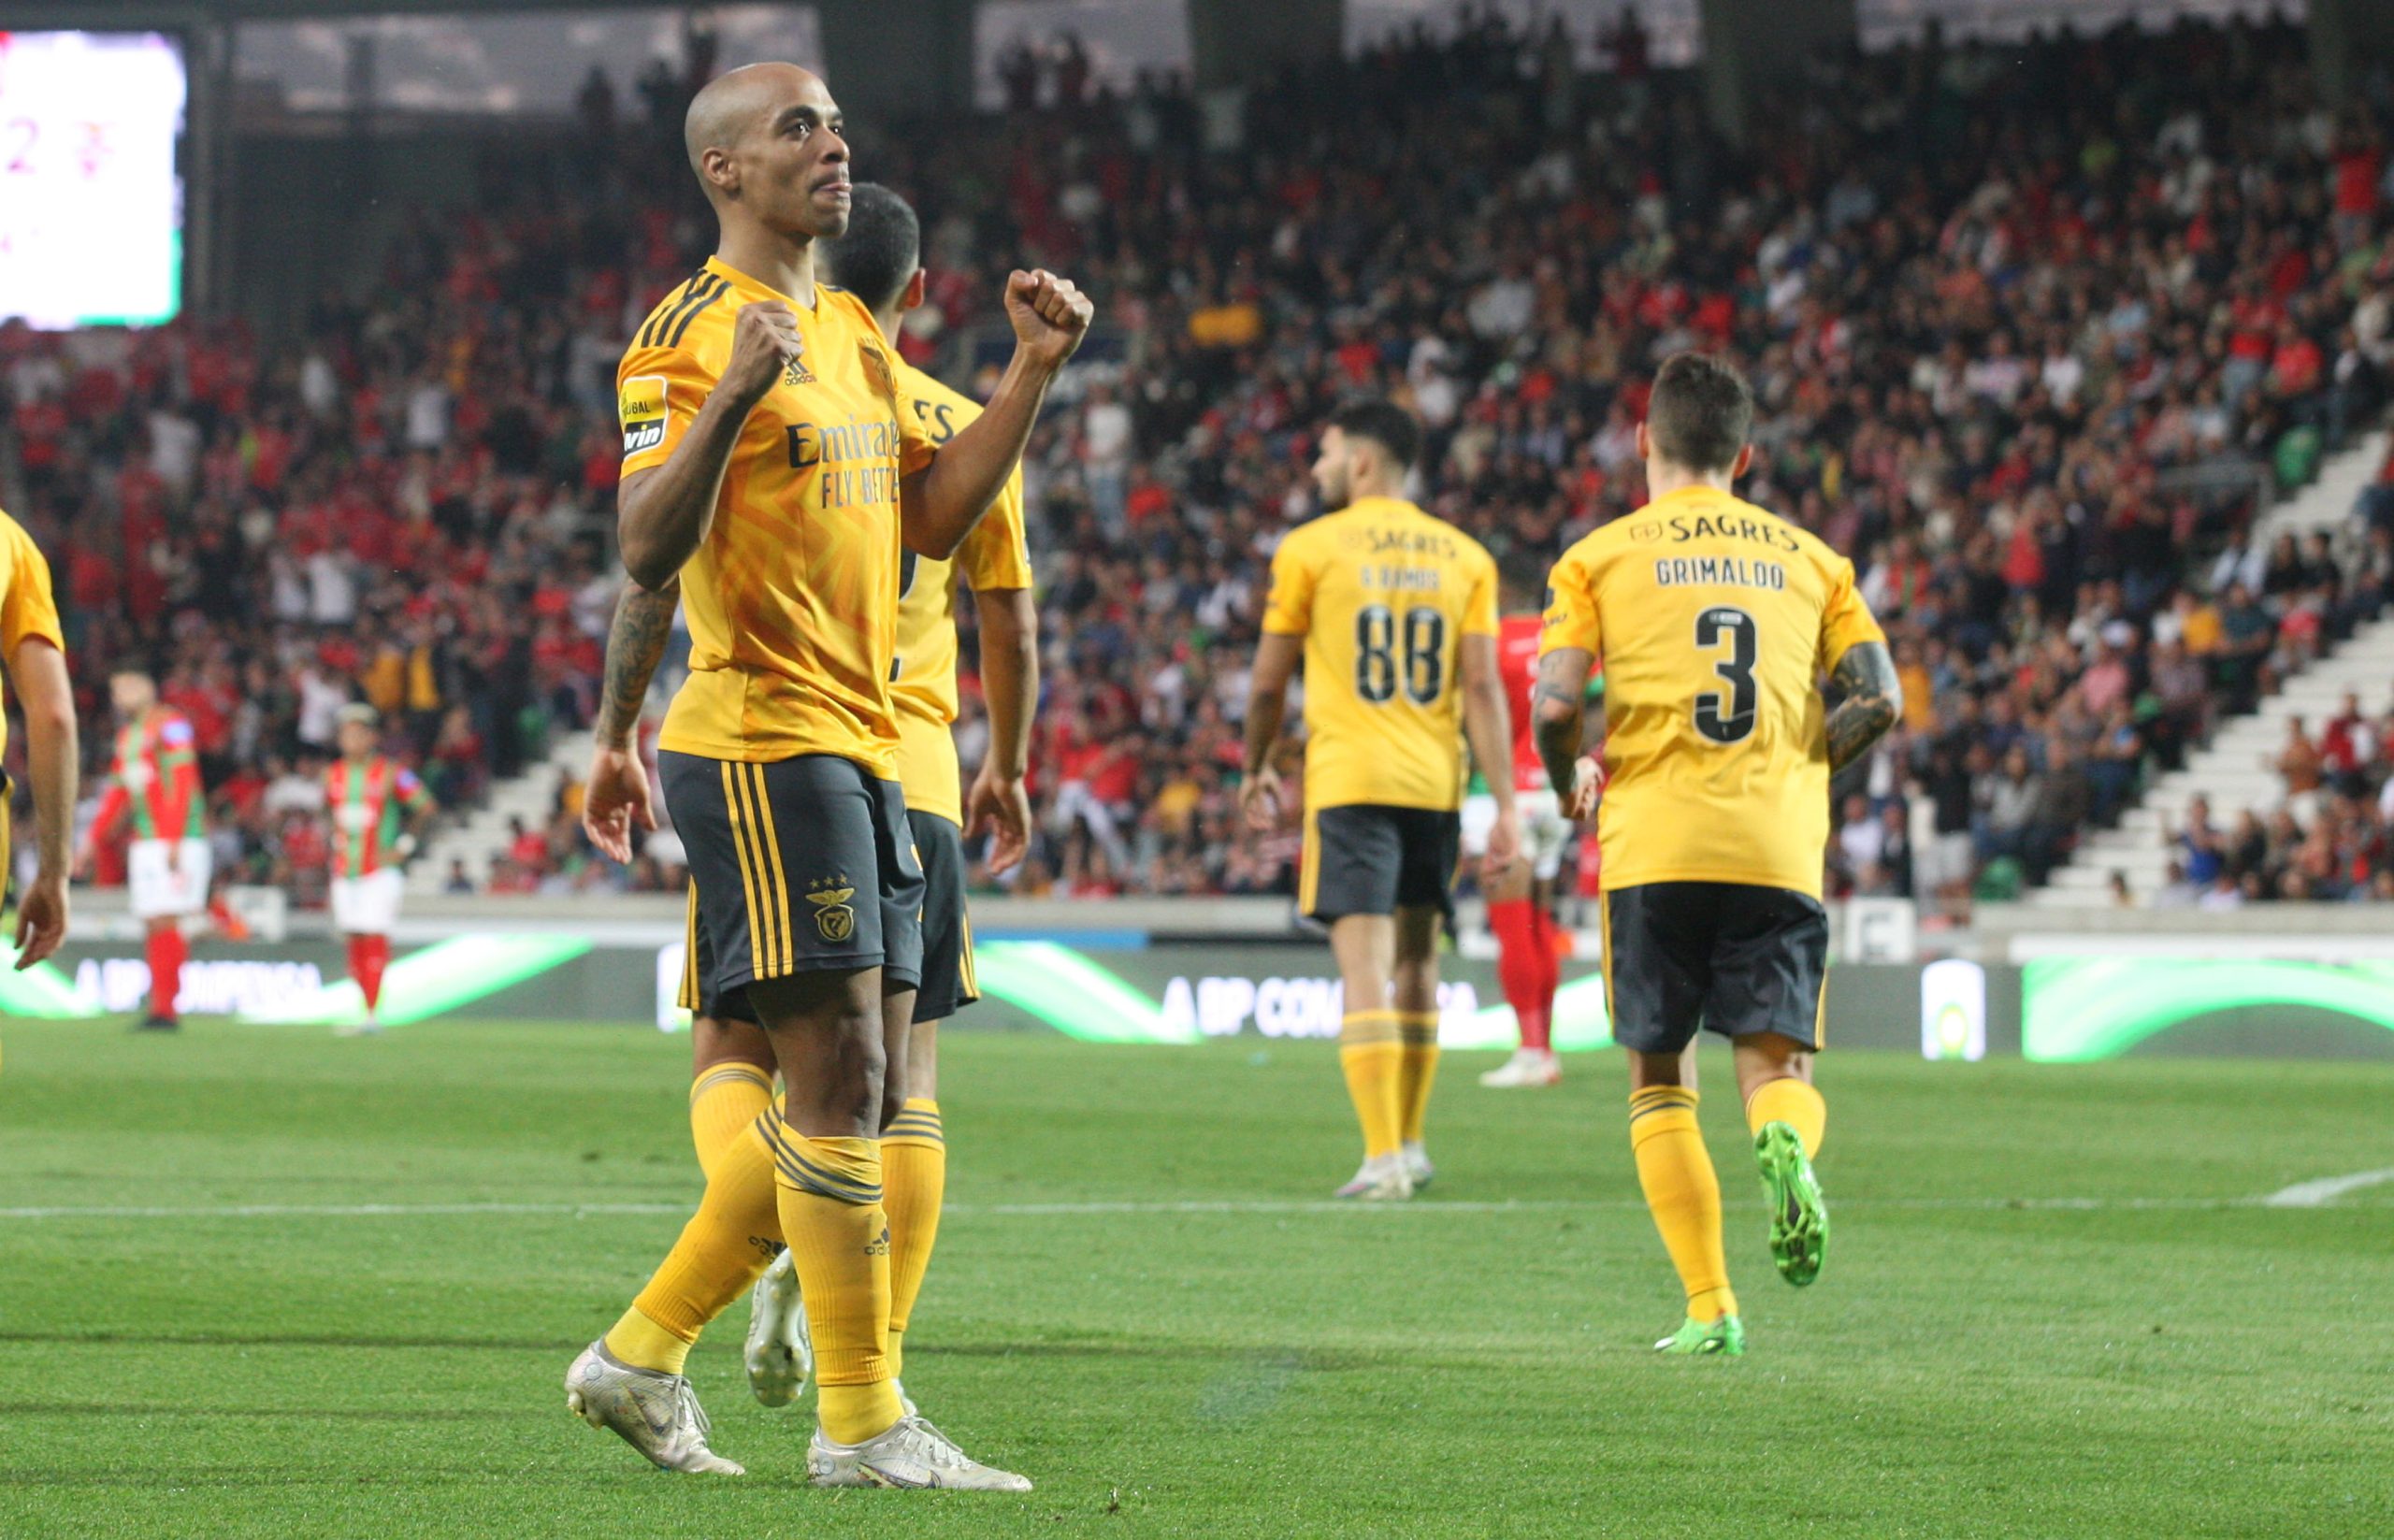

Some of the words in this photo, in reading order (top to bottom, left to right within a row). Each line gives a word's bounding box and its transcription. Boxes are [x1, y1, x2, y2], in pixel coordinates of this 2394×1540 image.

[6, 115, 40, 176] 2
[785, 374, 816, 386] adidas
[624, 424, 660, 452] win
[822, 471, 852, 509] FLY
[1669, 515, 1799, 552] SAGRES
[1656, 557, 1784, 591] GRIMALDO
[1357, 605, 1443, 703] 88
[1695, 608, 1756, 744] 3
